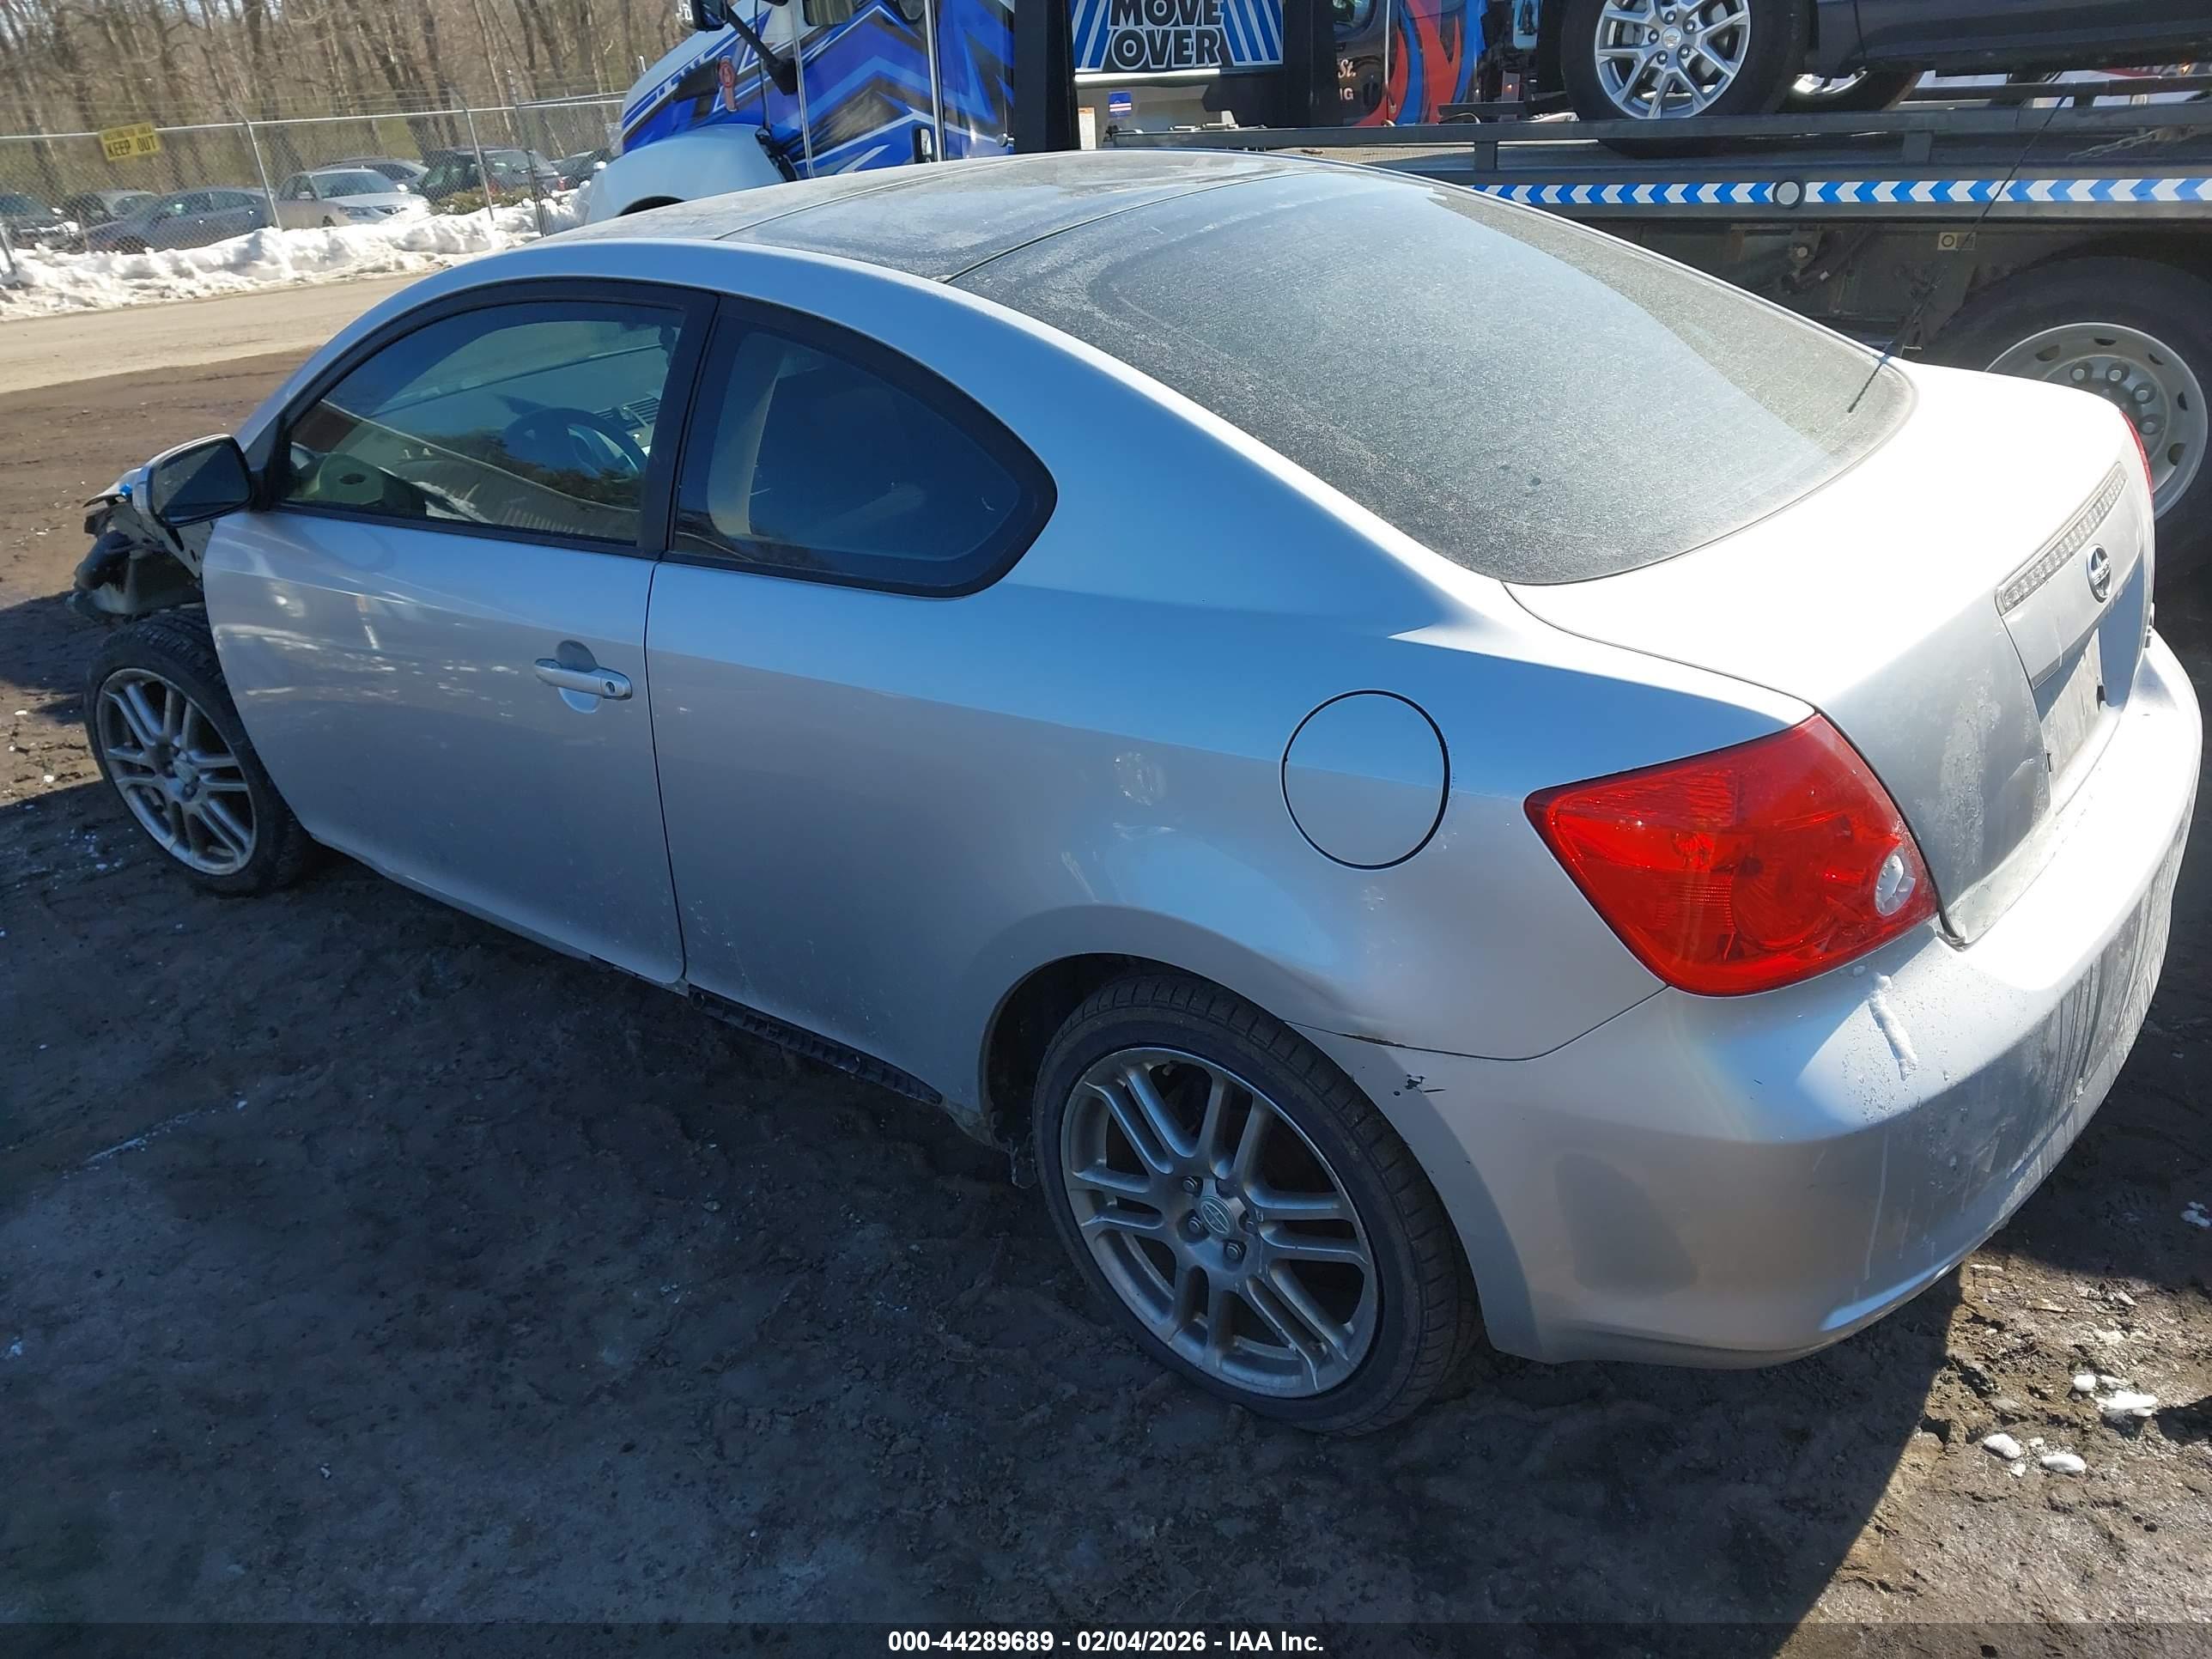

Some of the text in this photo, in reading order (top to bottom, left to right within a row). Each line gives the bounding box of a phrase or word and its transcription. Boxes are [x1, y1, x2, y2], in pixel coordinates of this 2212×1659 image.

[1110, 0, 1223, 27] MOVE
[1111, 28, 1222, 69] OVER
[1338, 58, 1357, 78] St.
[106, 135, 156, 158] KEEP OUT
